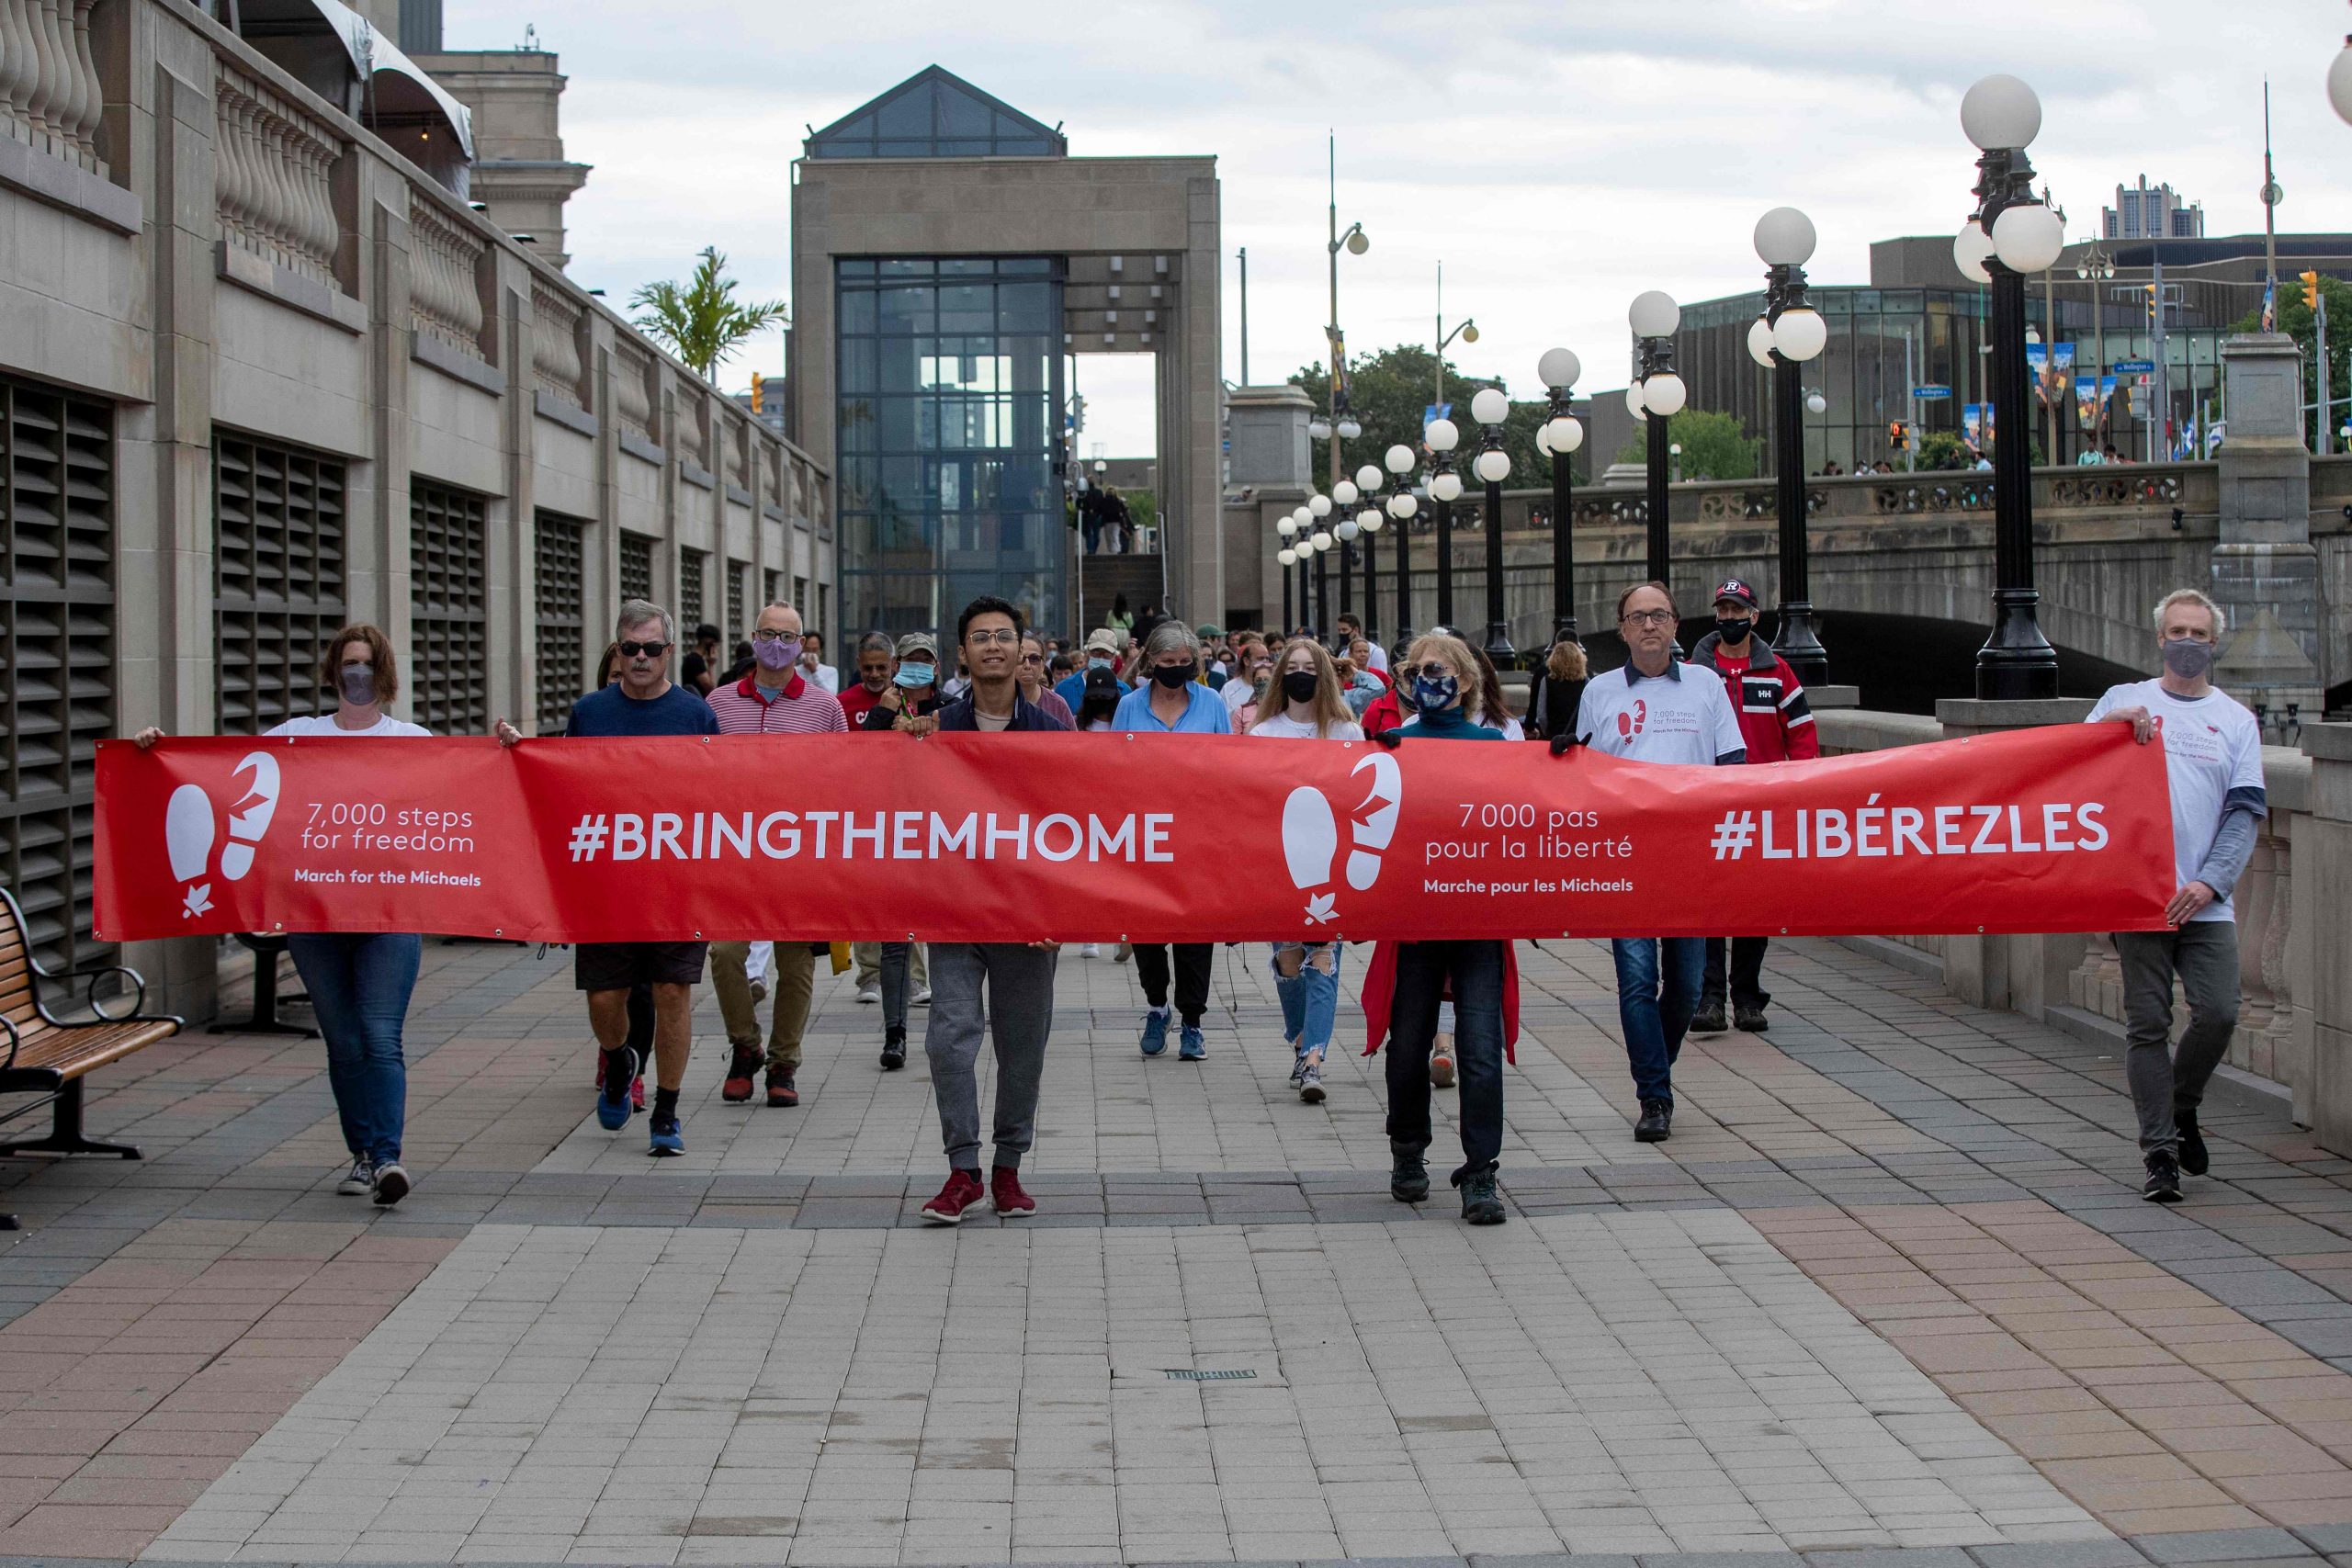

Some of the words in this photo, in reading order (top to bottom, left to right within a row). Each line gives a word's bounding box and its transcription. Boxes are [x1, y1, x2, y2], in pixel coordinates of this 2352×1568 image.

[308, 803, 386, 829] 7,000
[398, 807, 473, 833] steps
[1548, 810, 1599, 834] pas
[1710, 793, 2109, 861] #LIBÉREZLES
[300, 827, 342, 849] for
[352, 828, 474, 852] freedom
[568, 810, 1174, 863] #BRINGTHEMHOME
[1426, 841, 1490, 865] pour
[1502, 834, 1526, 858] la
[1539, 834, 1633, 858] liberté
[294, 868, 345, 883] March
[349, 869, 375, 884] for
[379, 870, 406, 884] the
[410, 871, 481, 886] Michaels
[1424, 879, 1486, 893] Marche
[1490, 882, 1530, 897] pour
[1534, 878, 1556, 892] les
[1561, 878, 1634, 892] Michaels
